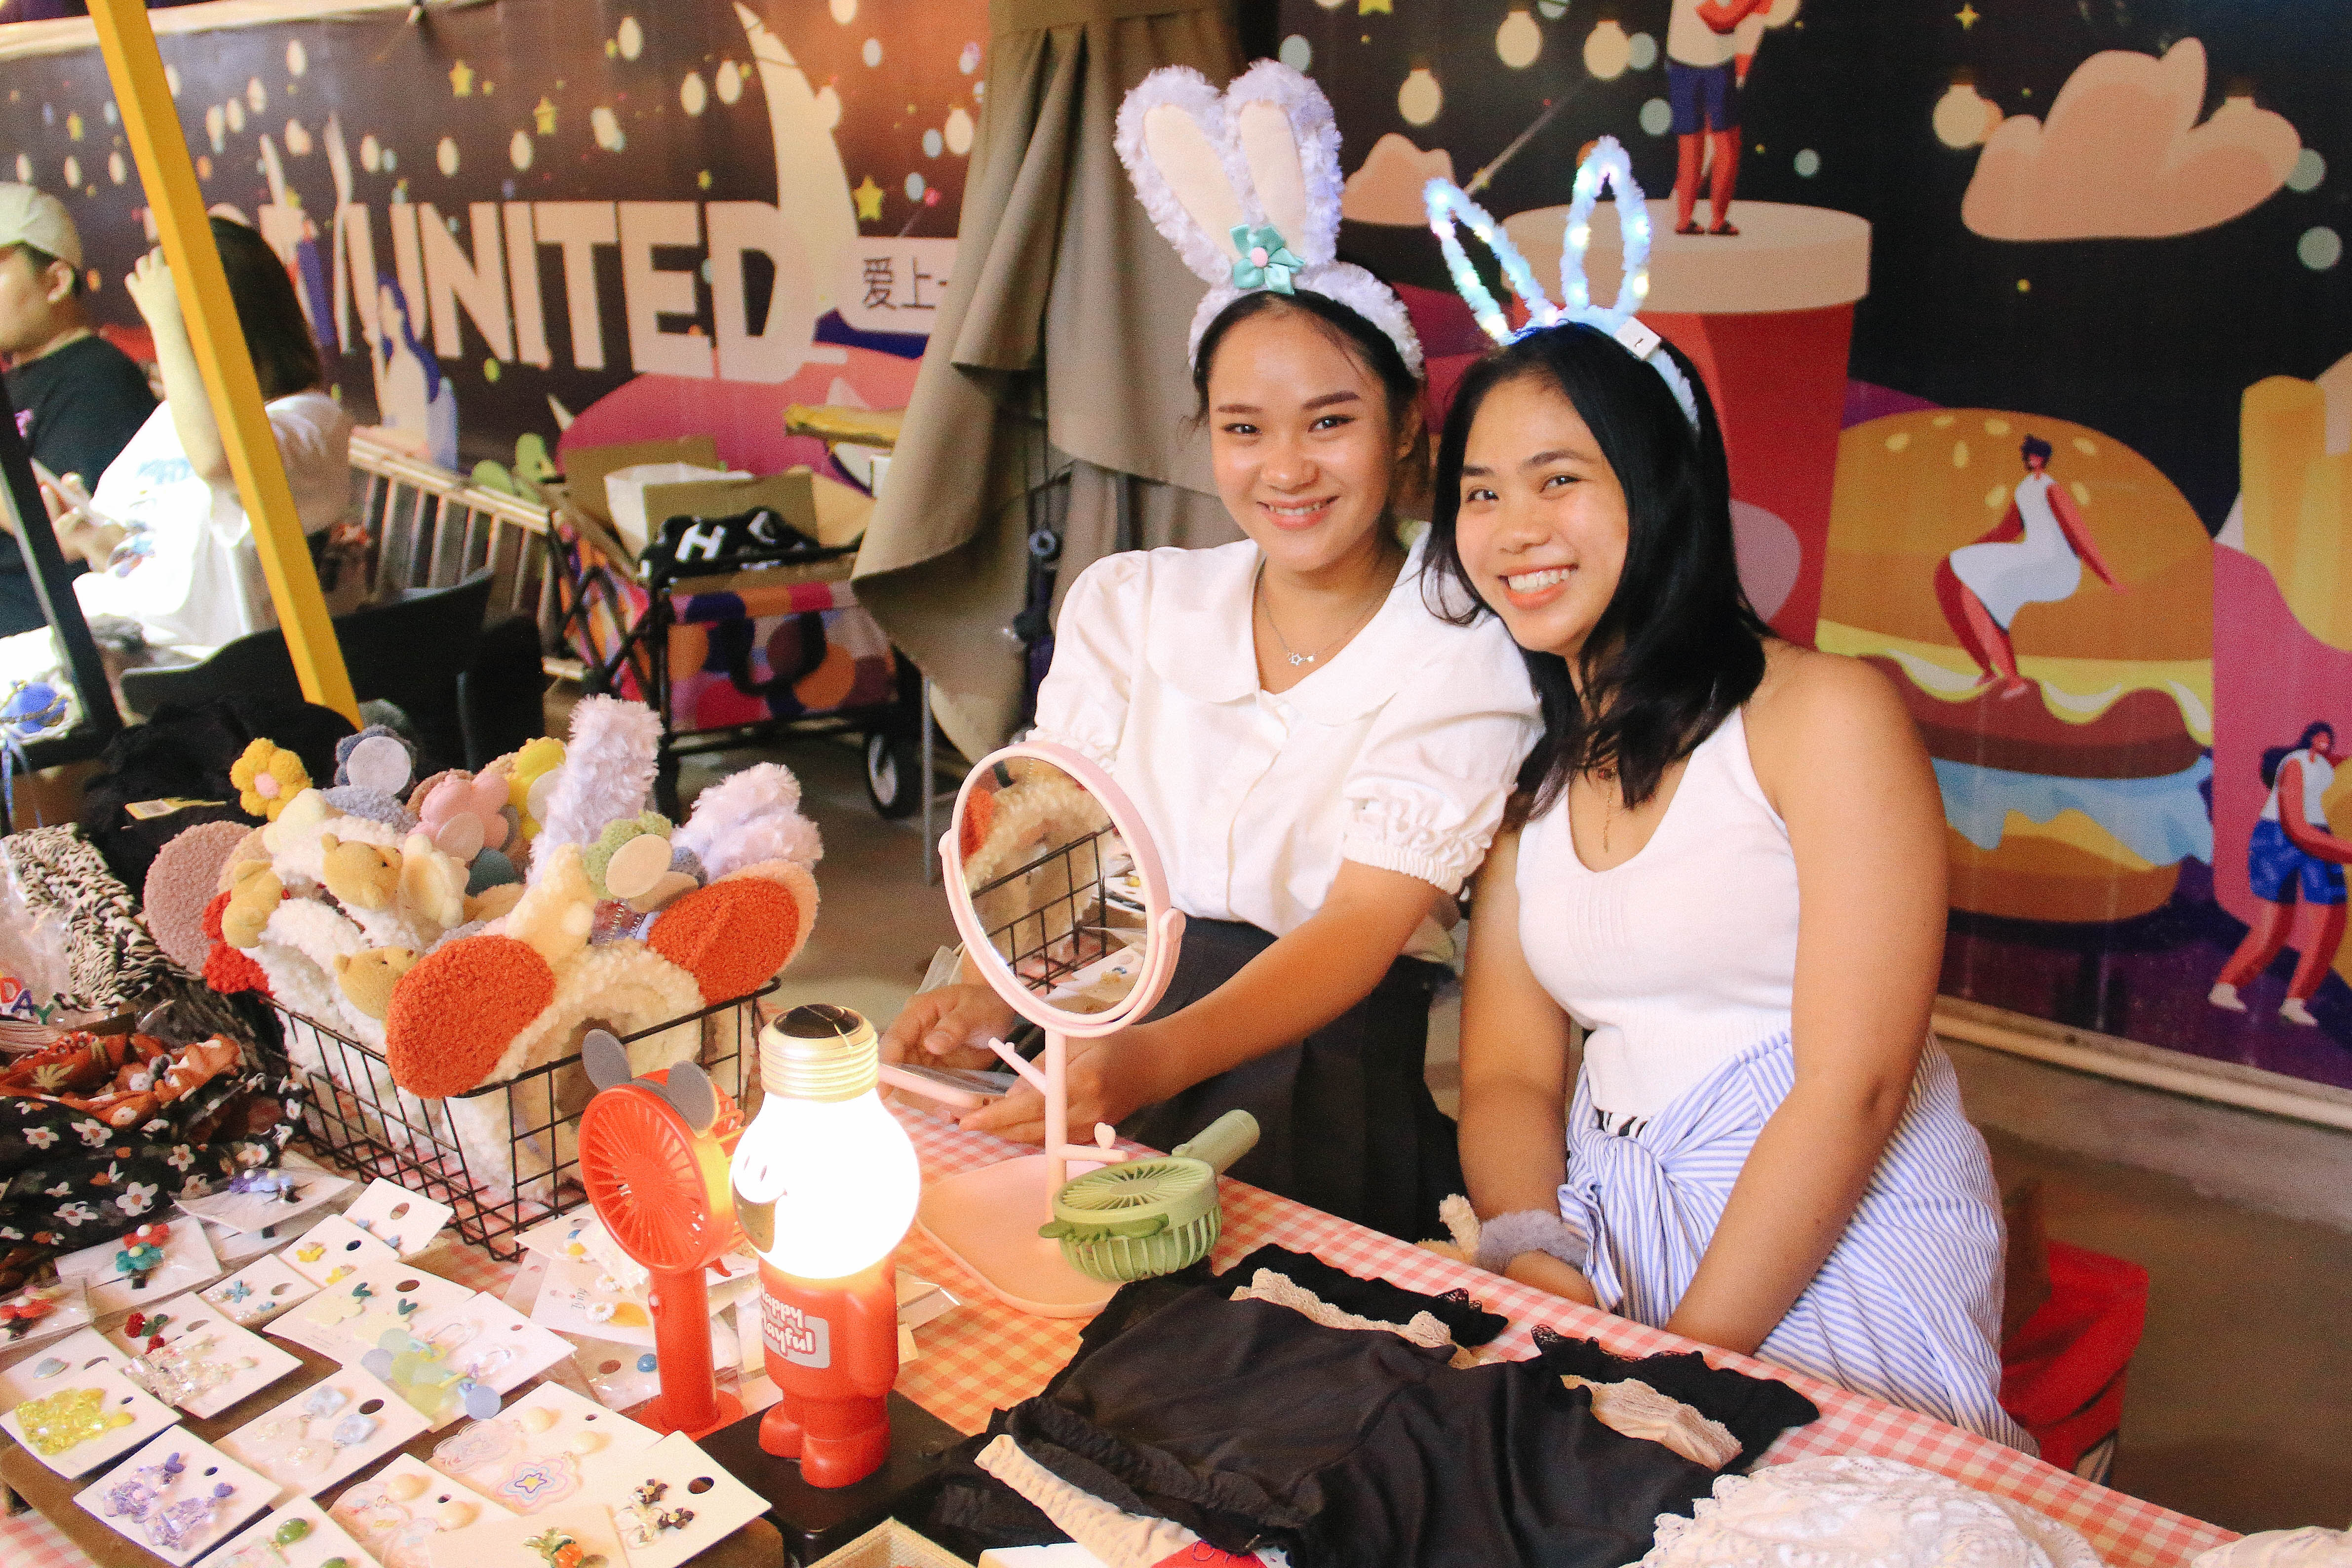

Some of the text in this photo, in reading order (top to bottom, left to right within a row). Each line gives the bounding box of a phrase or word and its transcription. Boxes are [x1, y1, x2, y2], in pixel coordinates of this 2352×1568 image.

[344, 199, 812, 384] UNITED
[863, 257, 948, 311] 爱上
[0, 977, 54, 1025] DAY
[763, 1309, 813, 1353] layful
